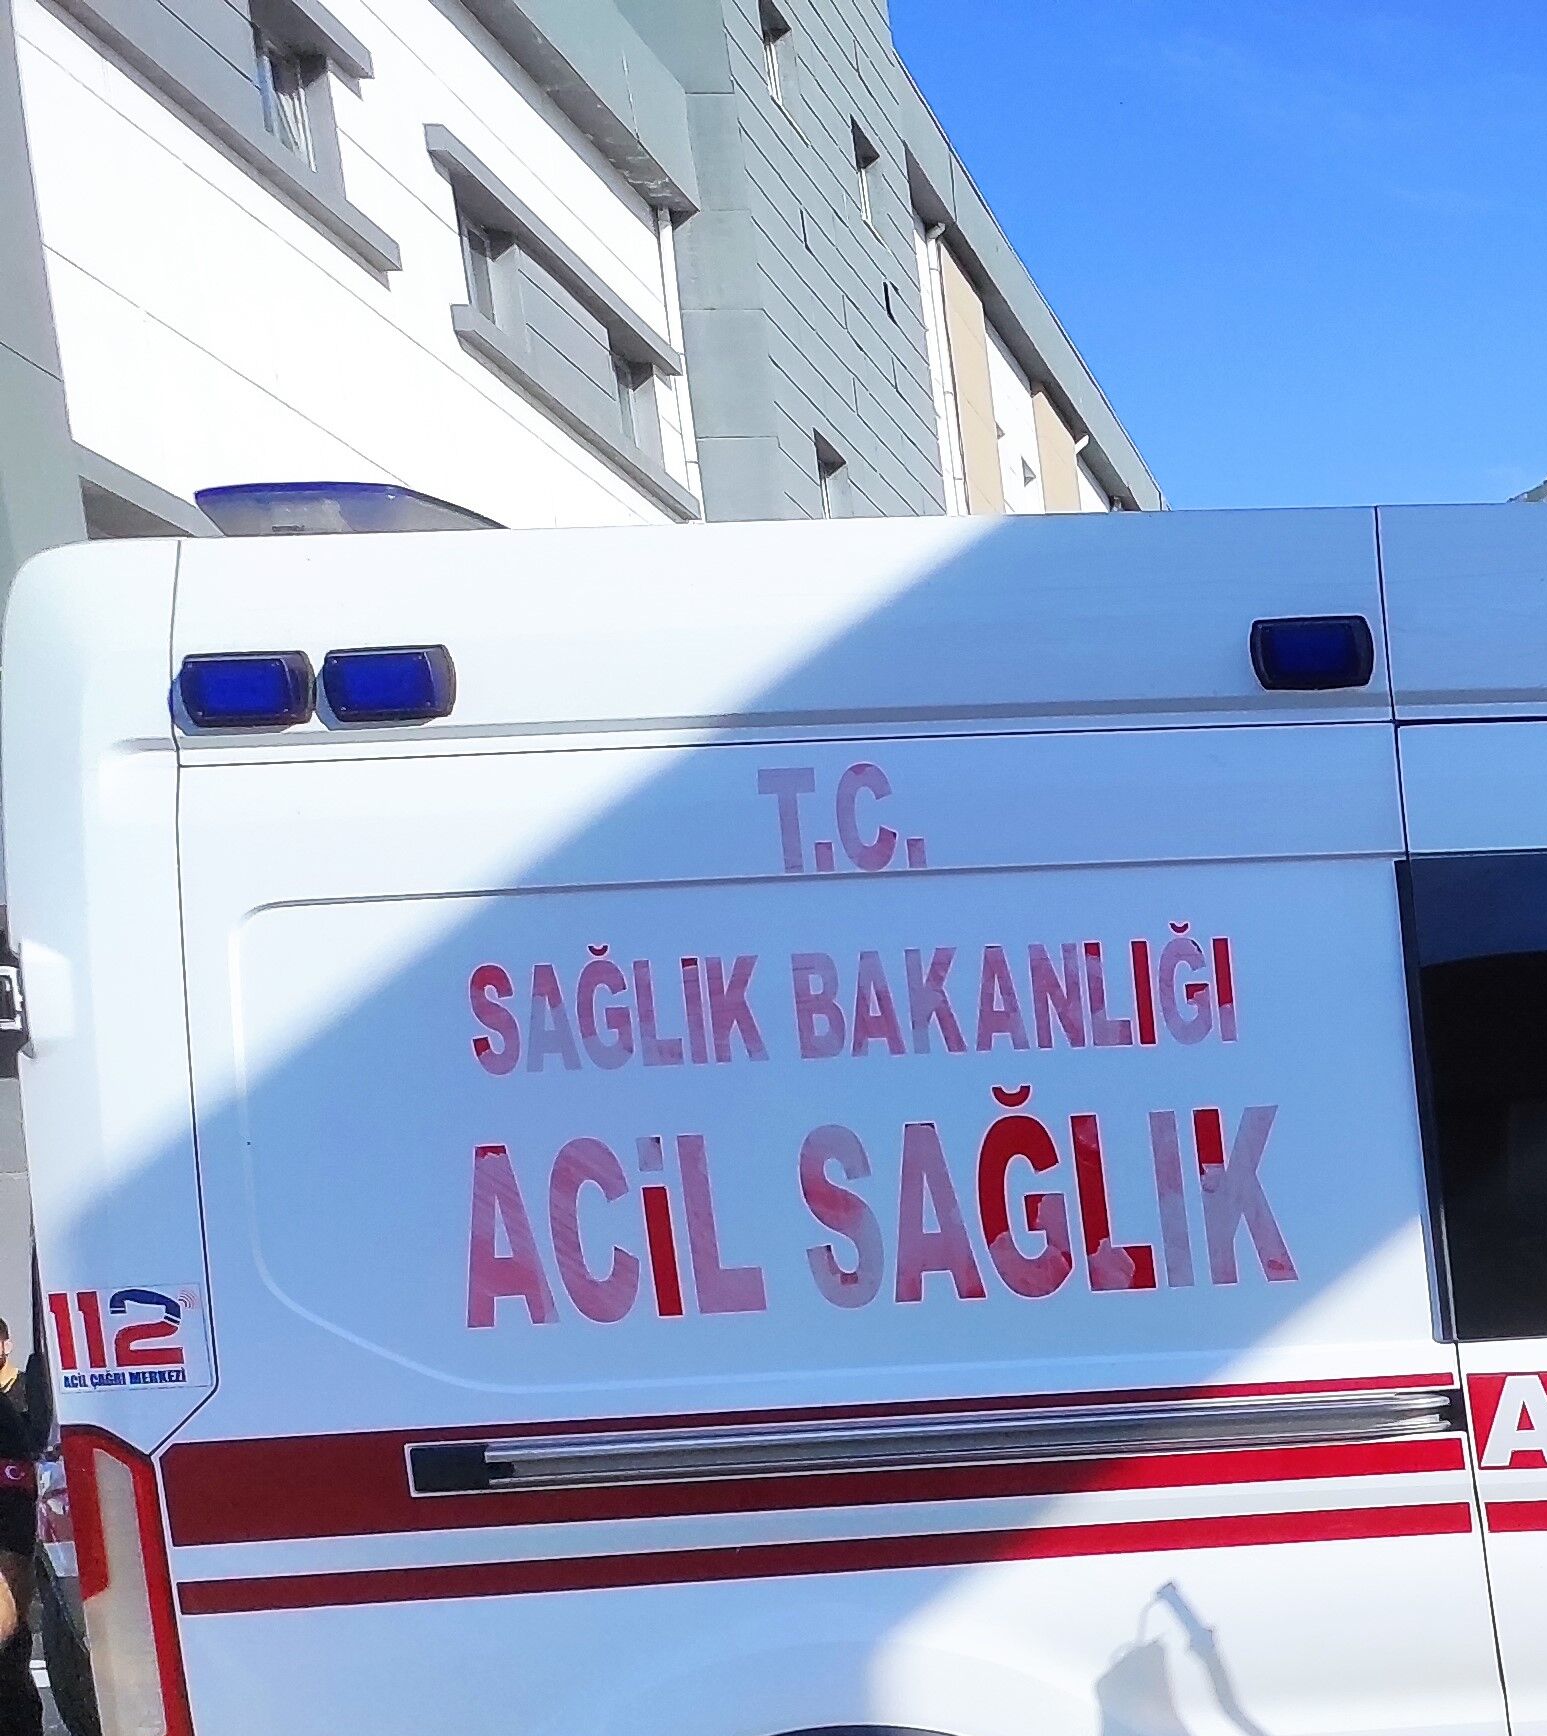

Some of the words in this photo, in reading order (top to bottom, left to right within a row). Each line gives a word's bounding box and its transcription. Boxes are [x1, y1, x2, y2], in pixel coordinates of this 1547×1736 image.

[757, 762, 928, 873] T.C.
[469, 944, 769, 1075] SAĞLIK
[791, 921, 1238, 1060] BAKANLIĞI
[466, 1133, 768, 1330] ACİL
[800, 1084, 1300, 1310] SAĞLIK
[48, 1288, 185, 1370] 112
